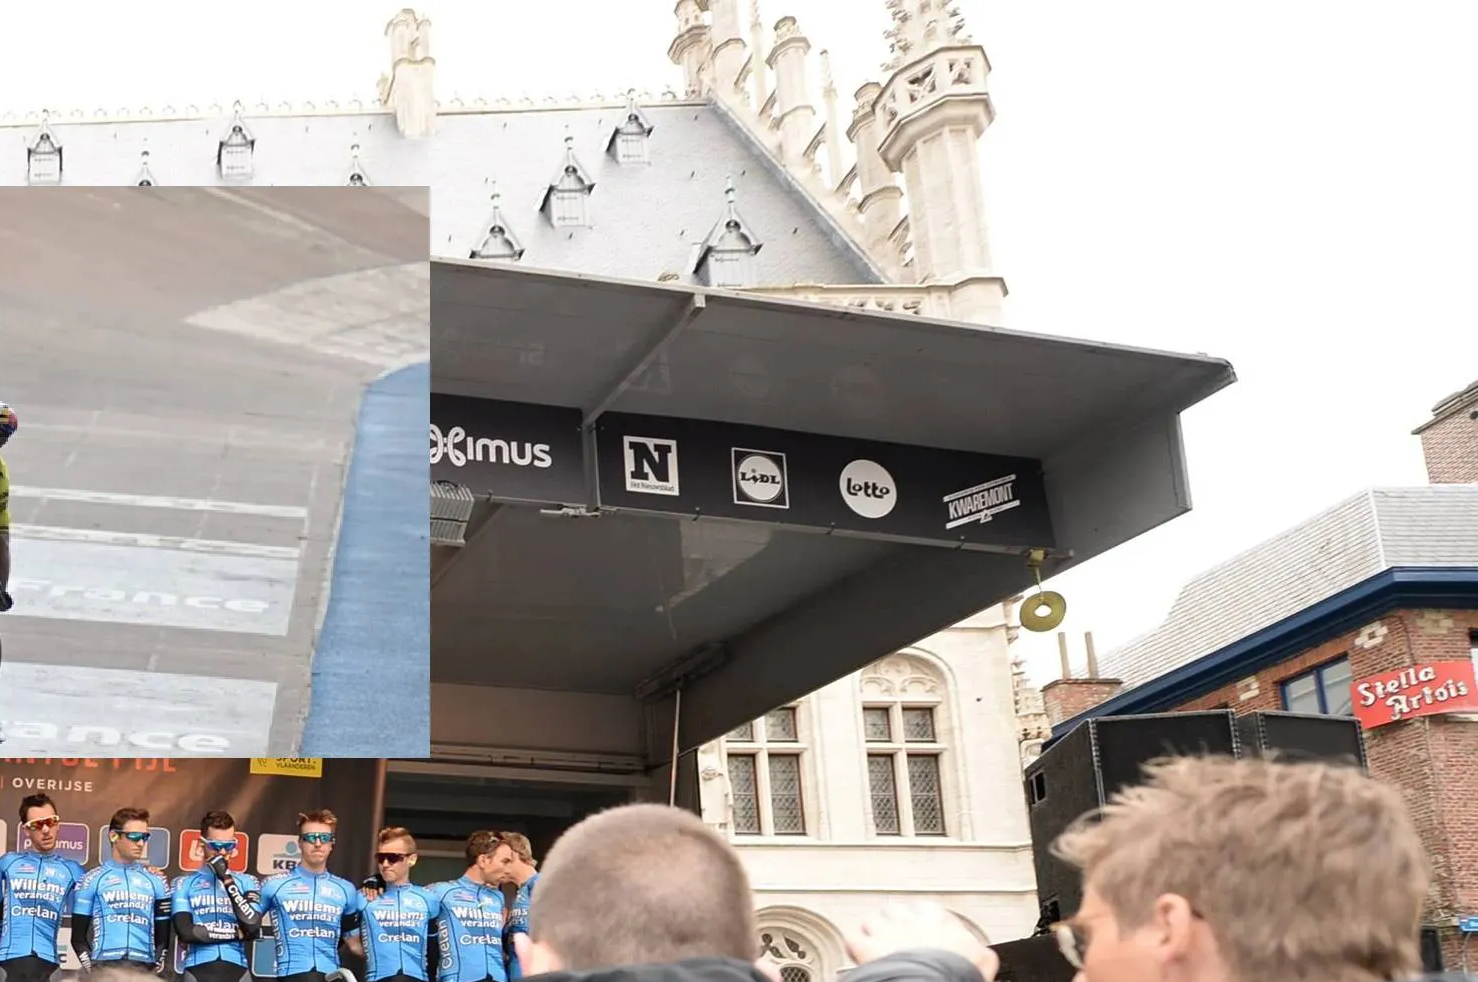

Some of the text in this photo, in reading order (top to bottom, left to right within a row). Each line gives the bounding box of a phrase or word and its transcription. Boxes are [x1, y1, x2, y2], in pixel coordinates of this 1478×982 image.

[629, 441, 672, 482] N
[948, 482, 1014, 520] KWAREMONT
[1356, 666, 1436, 706] Stella
[1385, 679, 1469, 721] Artois
[12, 777, 93, 793] OVERIJSE
[10, 878, 66, 896] Willems
[227, 883, 256, 920] Crelan
[282, 899, 342, 915] Willems
[10, 904, 58, 921] Crelan
[106, 913, 149, 926] Crelan
[373, 908, 427, 921] Willems
[451, 906, 503, 921] Willem
[288, 926, 335, 939] Crelan
[378, 932, 420, 943] Crelan
